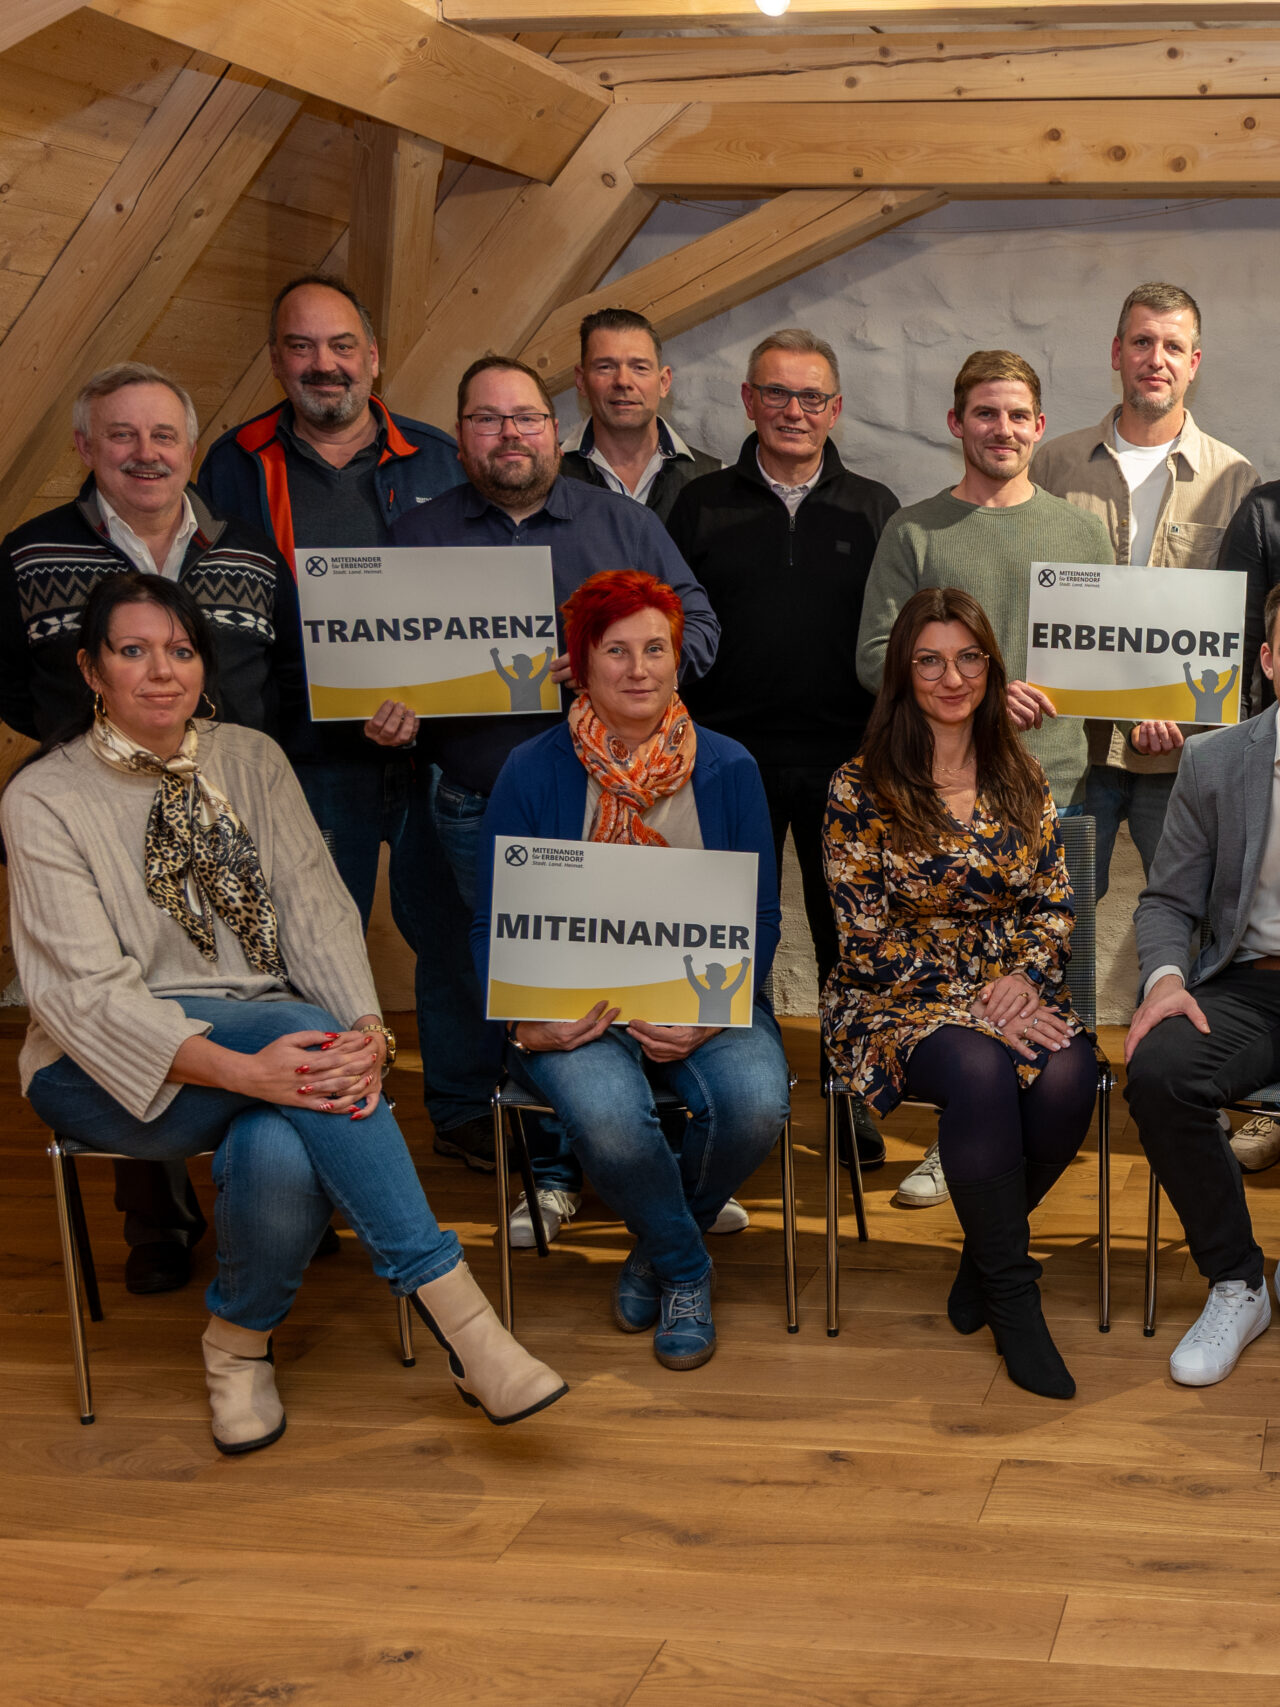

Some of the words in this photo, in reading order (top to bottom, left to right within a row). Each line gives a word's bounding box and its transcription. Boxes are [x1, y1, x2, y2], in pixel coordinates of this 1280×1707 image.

[304, 615, 555, 643] TRANSPARENZ
[1033, 623, 1240, 658] ERBENDORF
[533, 847, 584, 857] MITEINANDER
[541, 854, 584, 863] ERBENDORF
[497, 913, 750, 950] MITEINANDER
